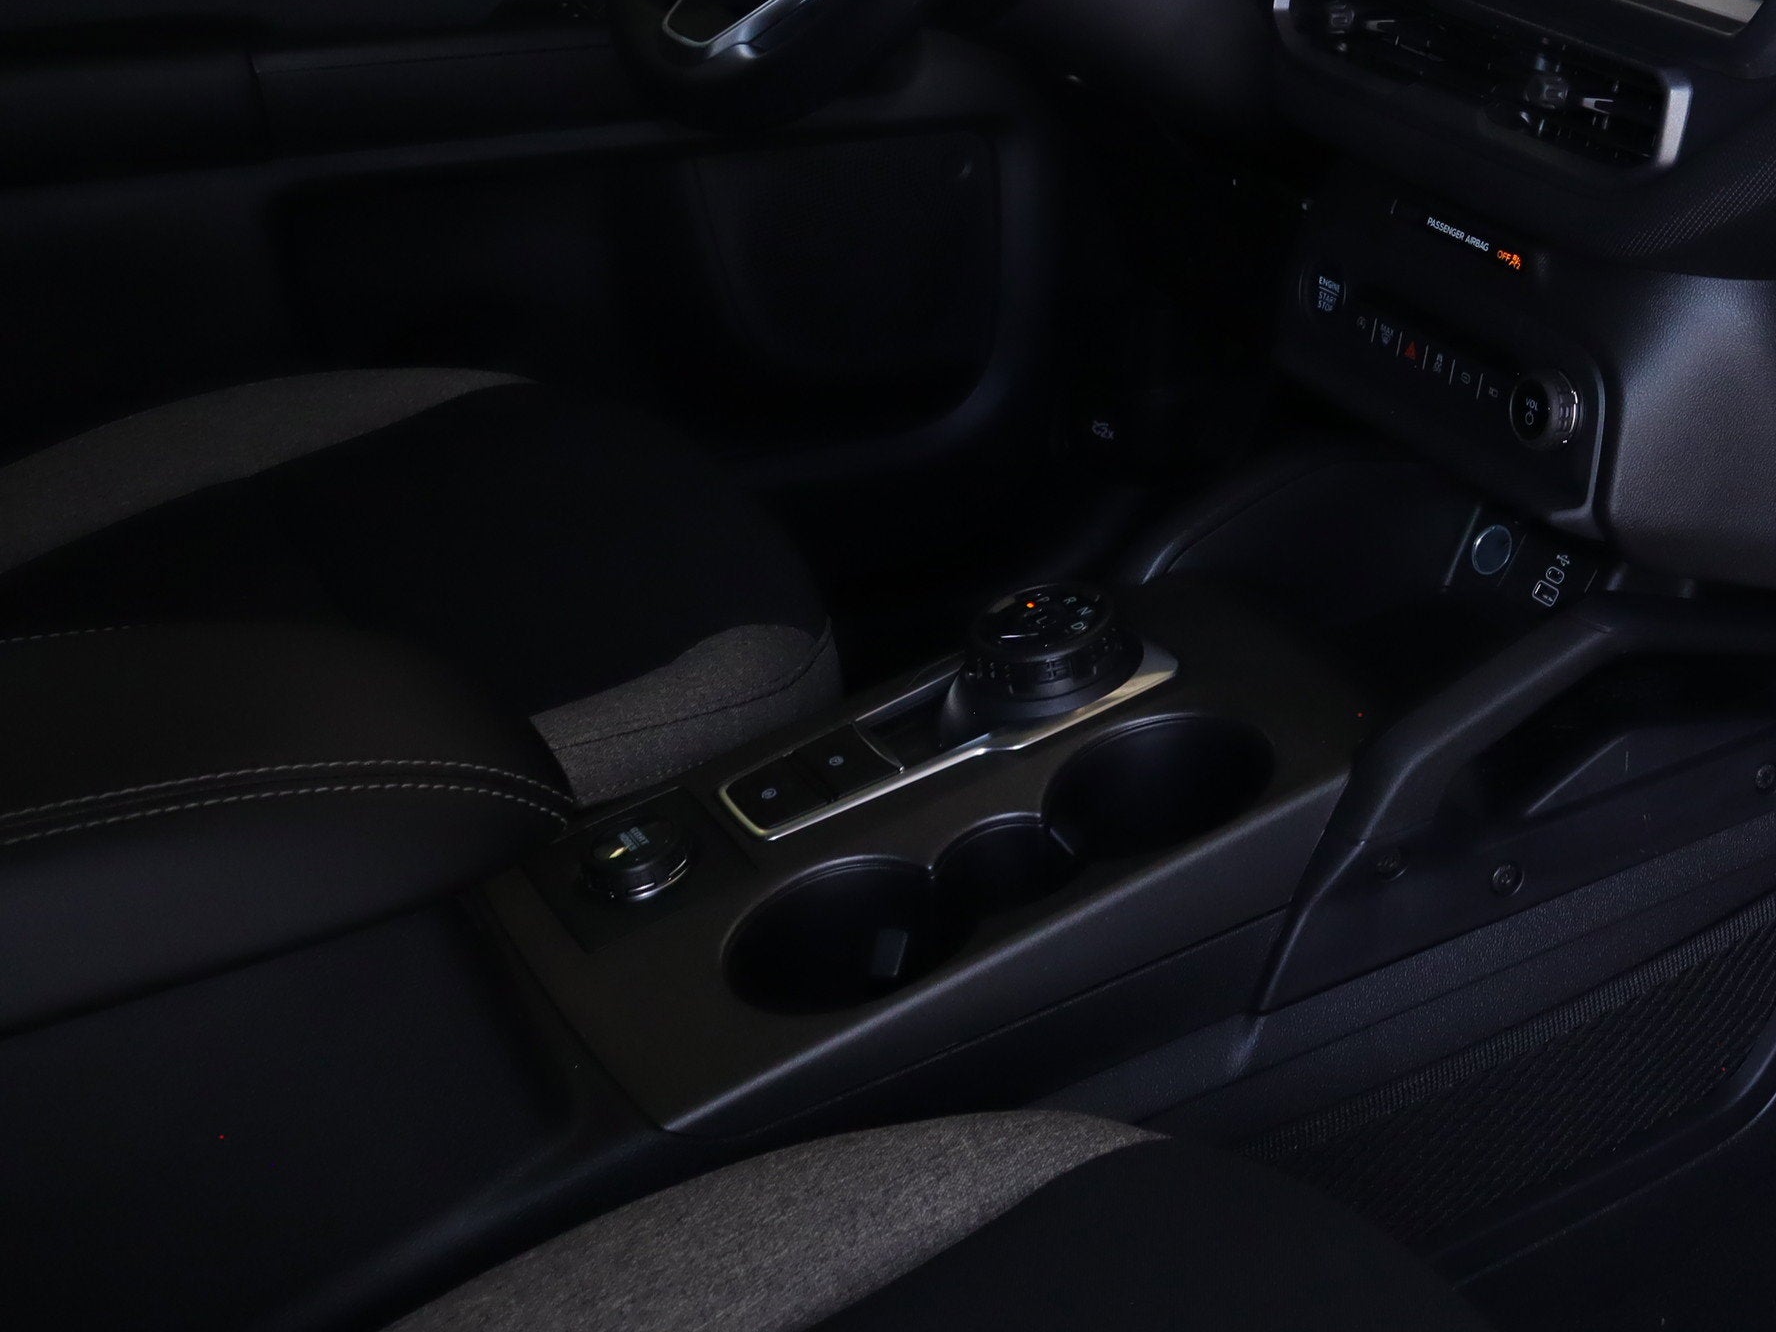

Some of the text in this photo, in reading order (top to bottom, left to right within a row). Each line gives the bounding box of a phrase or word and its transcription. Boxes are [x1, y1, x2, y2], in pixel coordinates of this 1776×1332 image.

[1426, 216, 1512, 262] PASSENGER AIRBAG OFF
[1525, 396, 1539, 412] VOL
